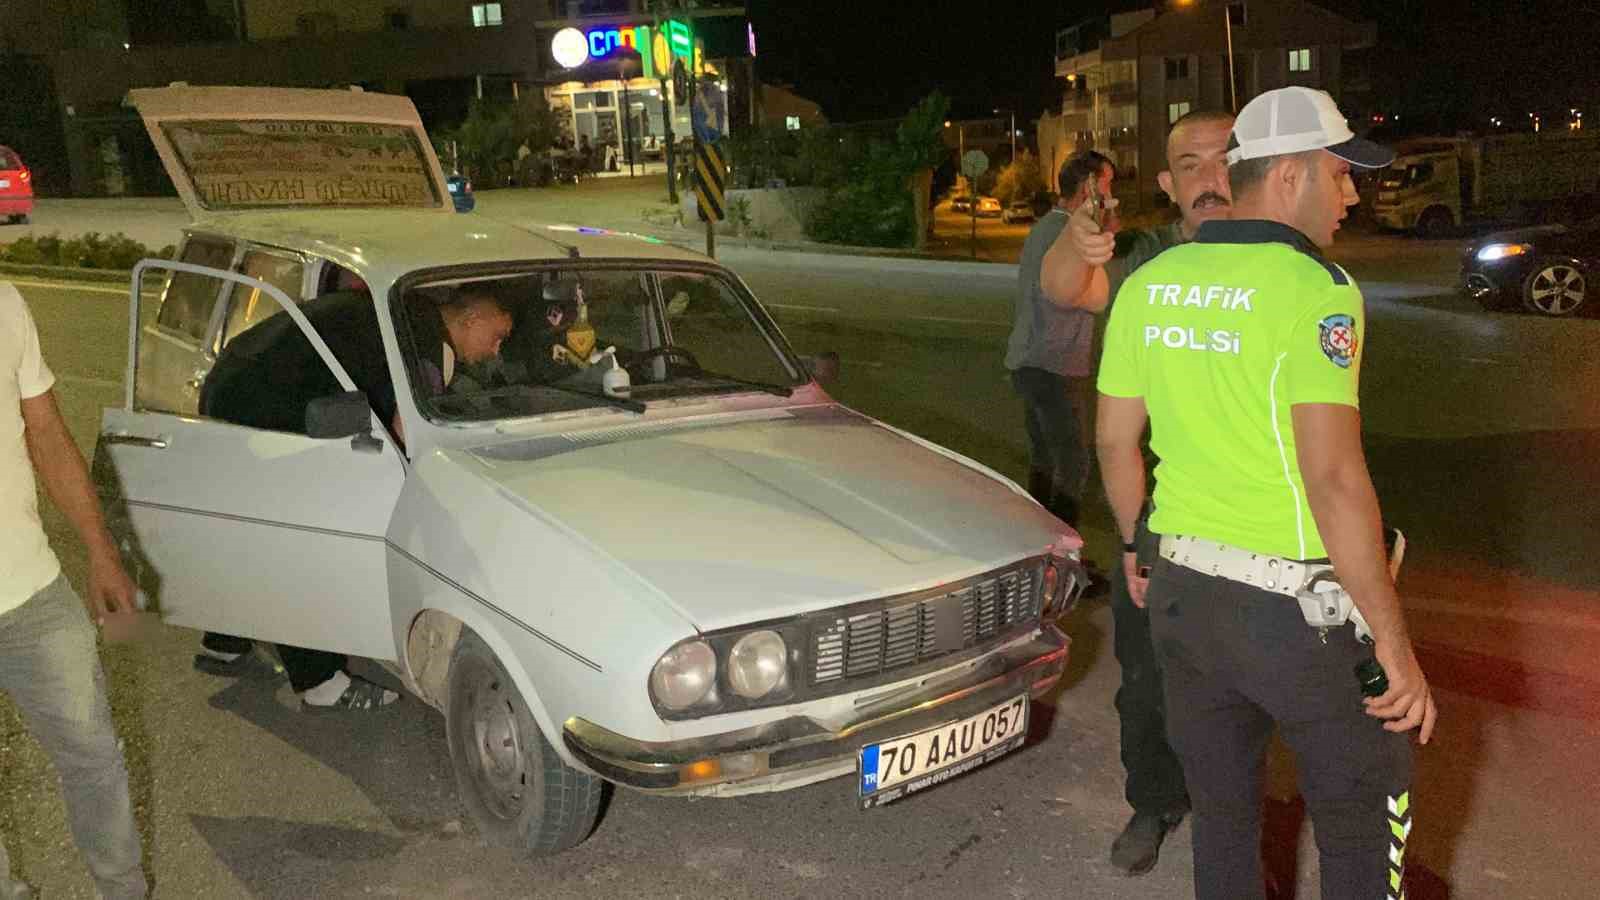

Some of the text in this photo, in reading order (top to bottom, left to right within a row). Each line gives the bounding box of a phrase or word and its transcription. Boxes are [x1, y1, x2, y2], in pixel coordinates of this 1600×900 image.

[881, 742, 917, 784] 70
[925, 721, 977, 768] AAU
[981, 701, 1024, 745] 057
[864, 773, 878, 785] TR
